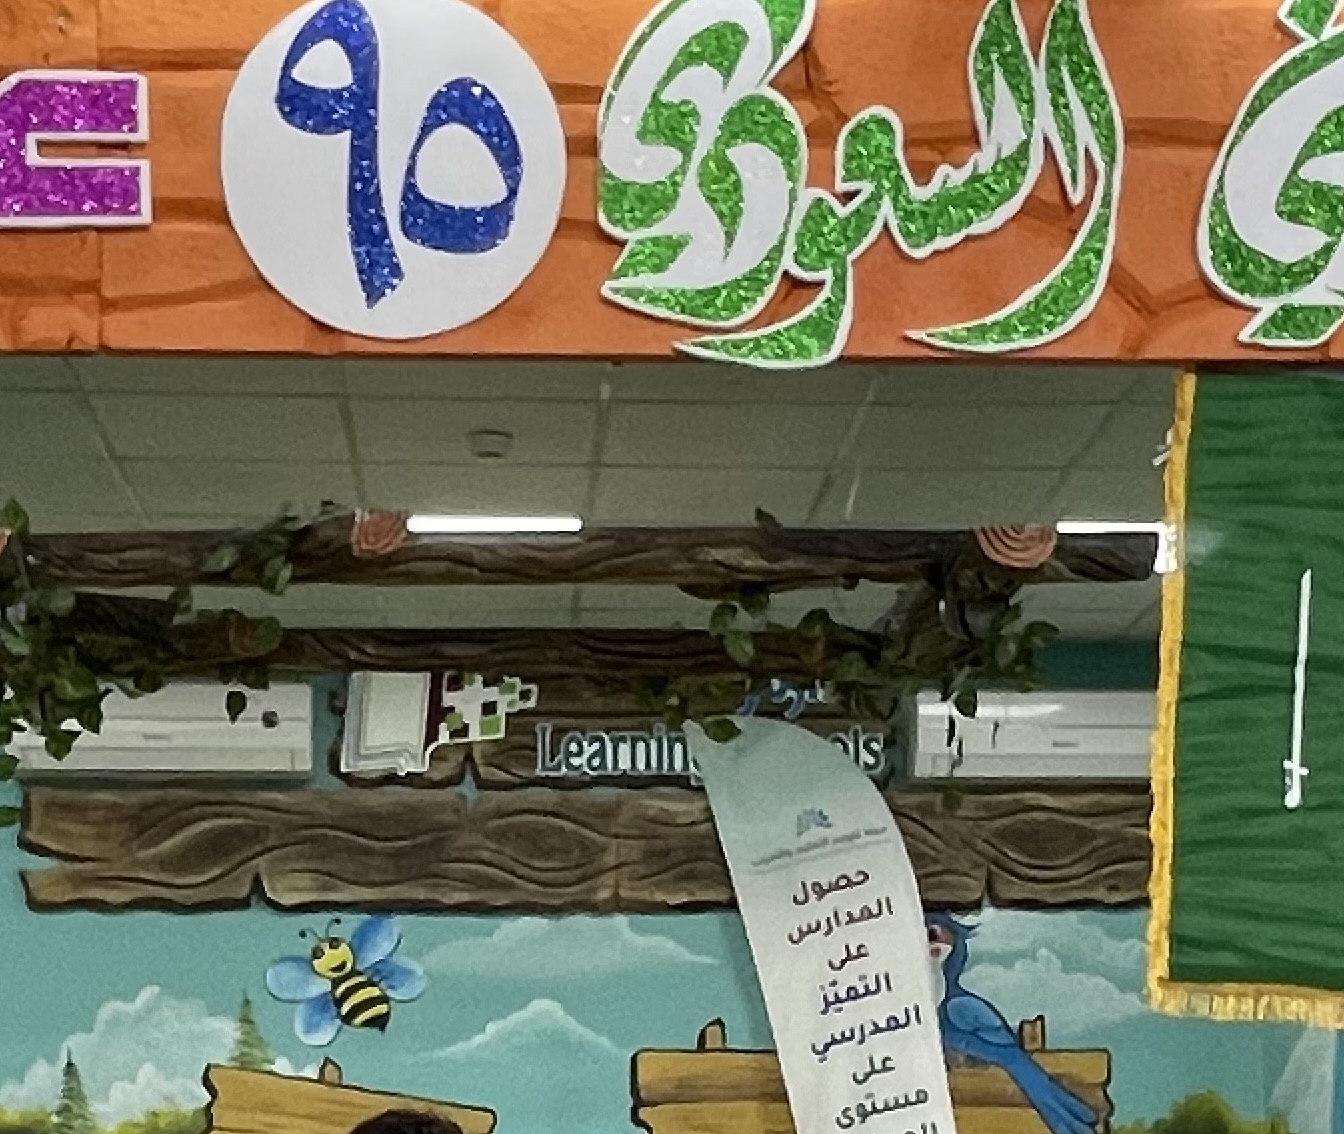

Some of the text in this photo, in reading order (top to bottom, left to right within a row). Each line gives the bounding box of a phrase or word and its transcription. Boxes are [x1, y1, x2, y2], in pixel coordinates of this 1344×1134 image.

[275, 0, 523, 309] ٩٥
[598, 0, 1126, 369] السعودي
[792, 869, 870, 906] حصول
[786, 896, 894, 945] المدارس
[828, 942, 869, 971] على
[810, 1004, 923, 1061] المدرسي
[852, 1055, 896, 1086] على
[834, 1088, 929, 1131] مستوى
